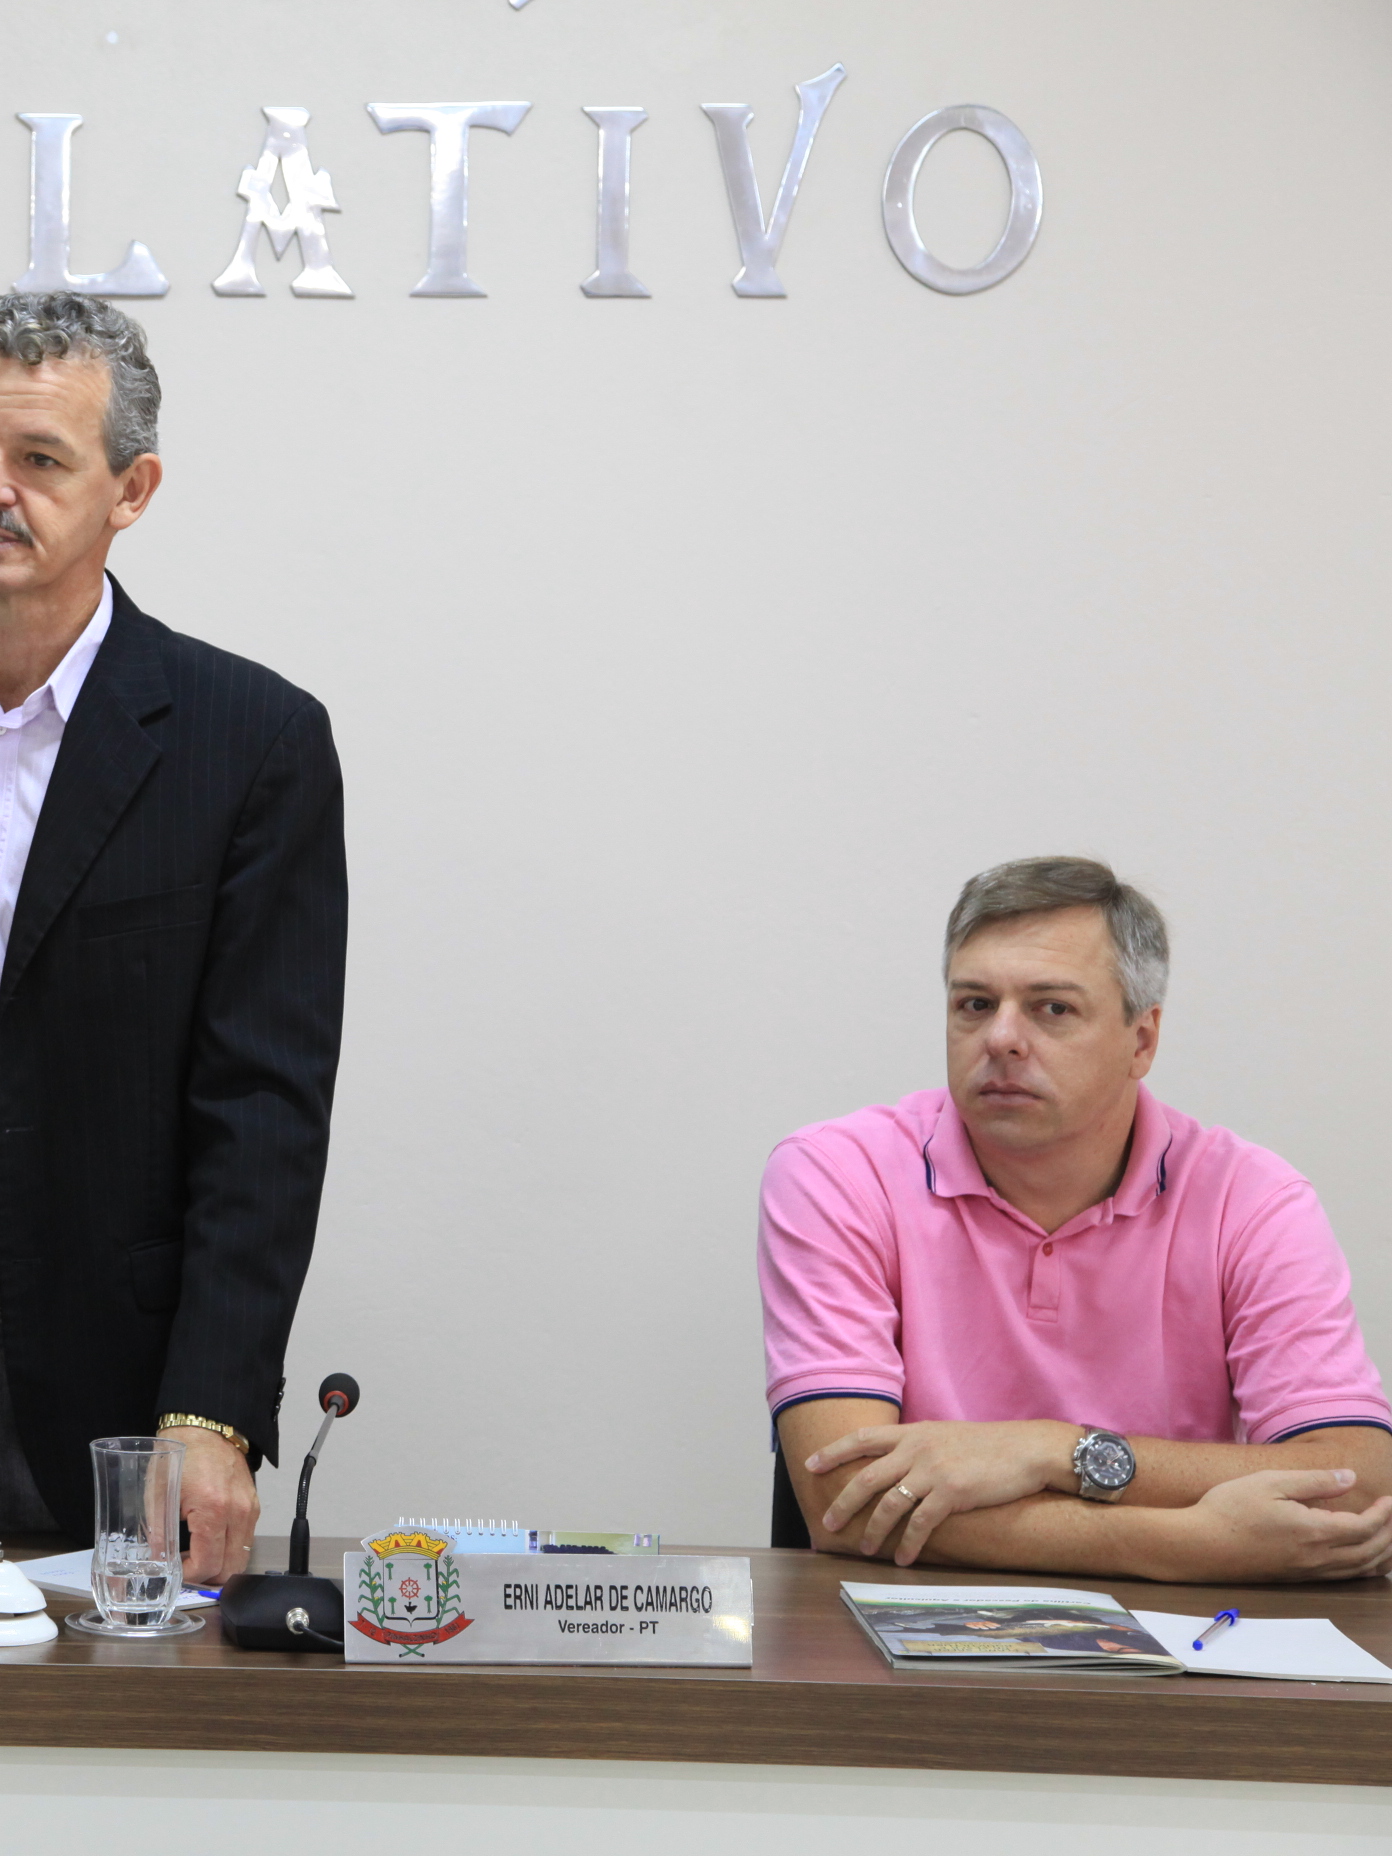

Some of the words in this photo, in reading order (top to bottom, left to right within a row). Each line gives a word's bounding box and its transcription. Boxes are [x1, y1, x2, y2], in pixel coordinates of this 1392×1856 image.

[503, 1583, 539, 1611] ERNI
[544, 1584, 604, 1611] ADELAR
[609, 1585, 630, 1612] DE
[634, 1584, 713, 1614] CAMARGO
[558, 1619, 625, 1634] Vereador
[639, 1620, 659, 1634] PT
